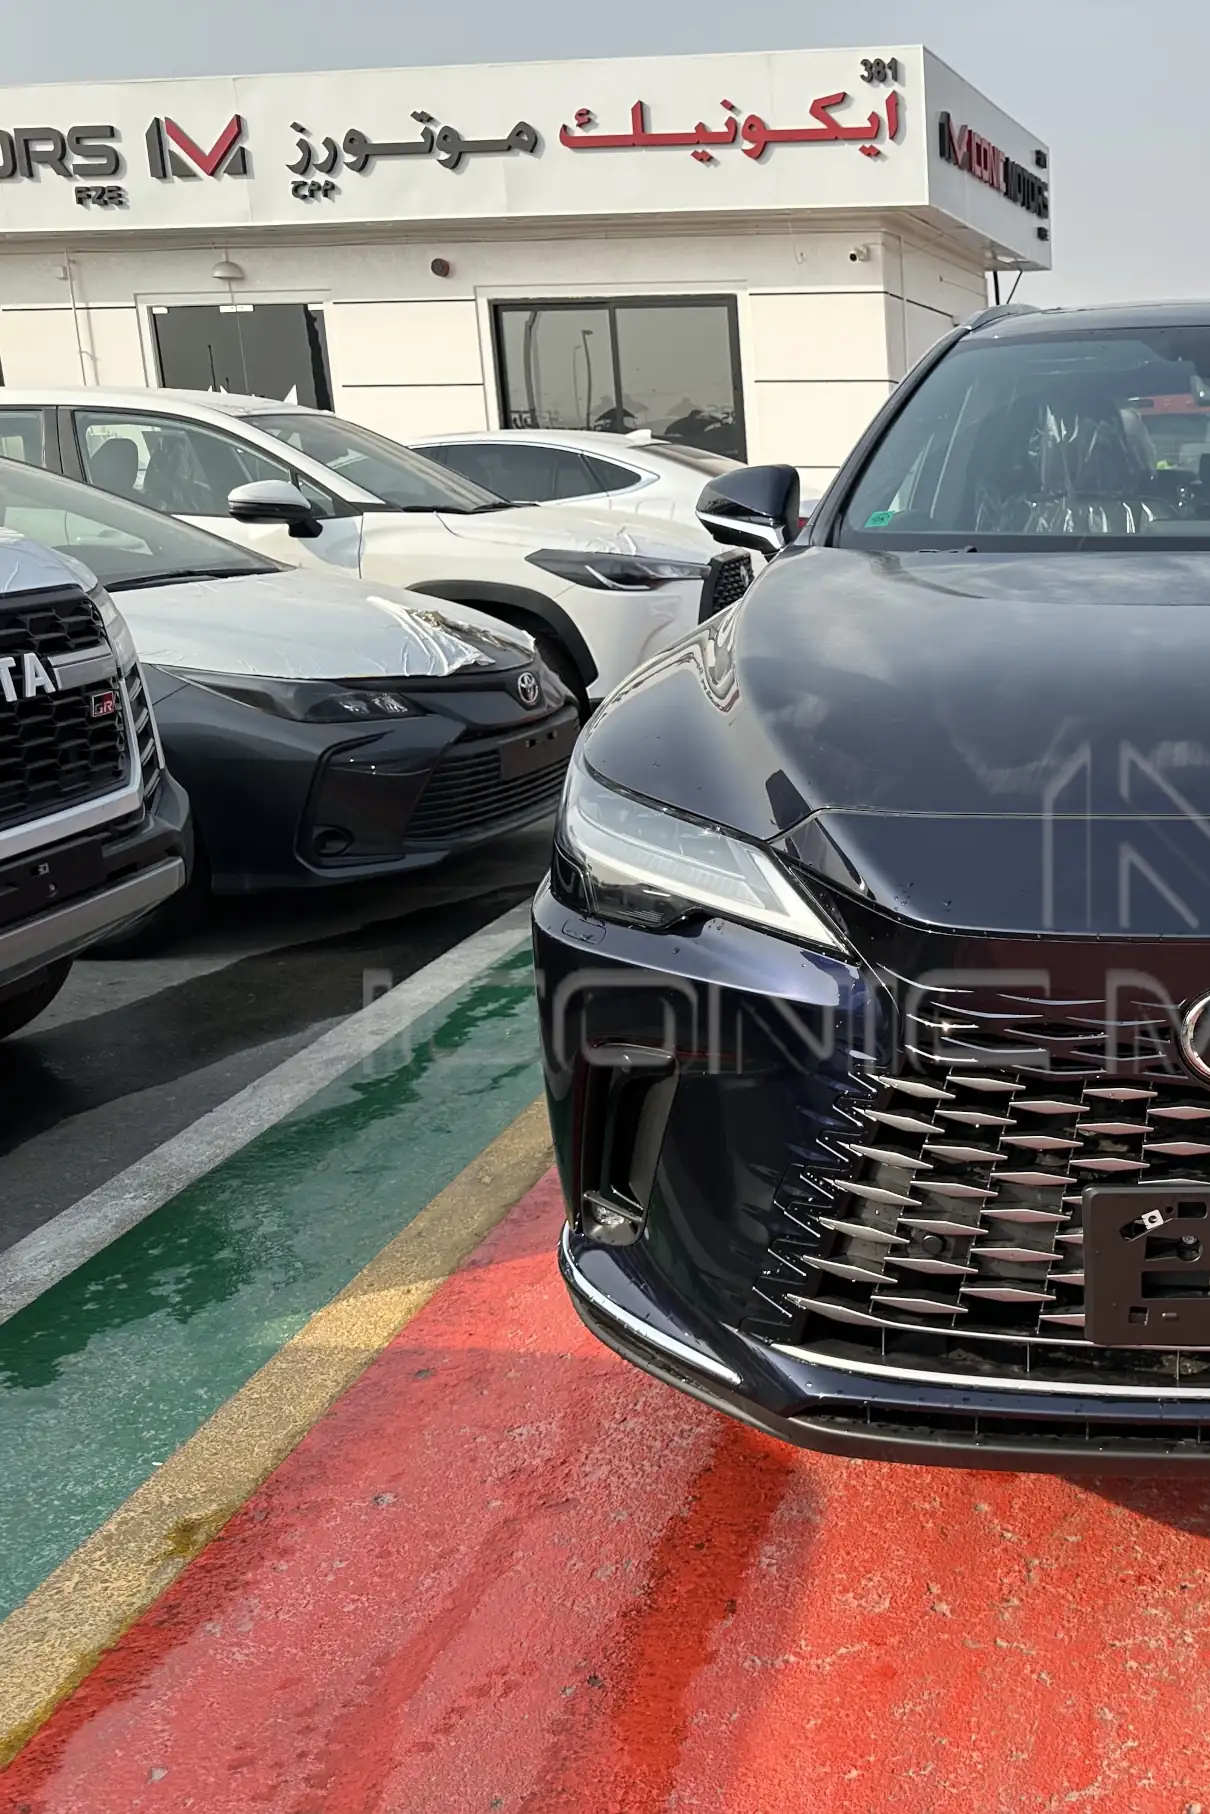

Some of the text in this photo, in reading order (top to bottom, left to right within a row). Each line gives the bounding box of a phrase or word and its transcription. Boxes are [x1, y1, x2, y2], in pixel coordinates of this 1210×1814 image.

[860, 57, 899, 83] 381
[0, 124, 120, 179] RS
[285, 110, 538, 176] موتورز
[75, 185, 125, 206] FZE
[94, 700, 114, 714] GR
